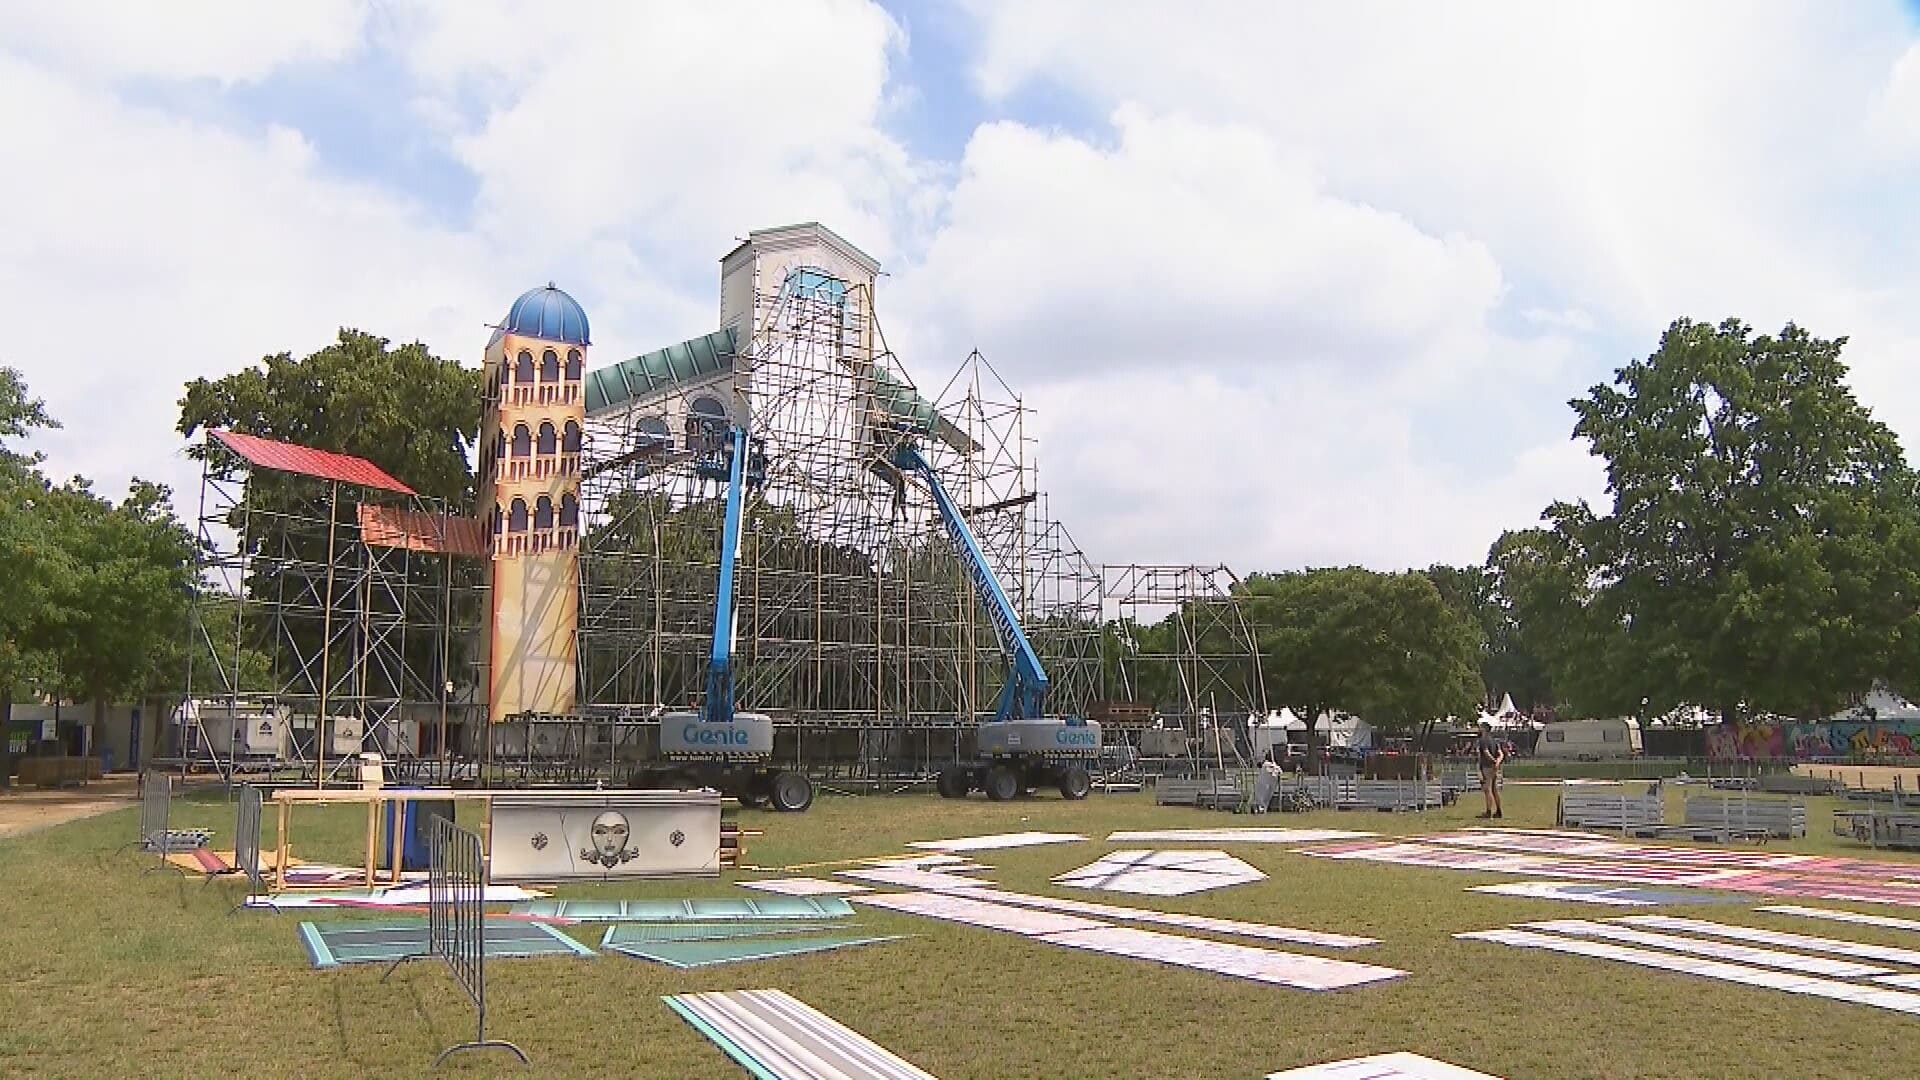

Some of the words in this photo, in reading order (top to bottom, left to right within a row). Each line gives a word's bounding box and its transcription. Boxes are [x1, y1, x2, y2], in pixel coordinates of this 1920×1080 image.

[947, 520, 977, 571] LUMAR
[974, 574, 1021, 654] VERHUUR
[683, 724, 748, 745] Genie
[1056, 730, 1096, 745] Genie
